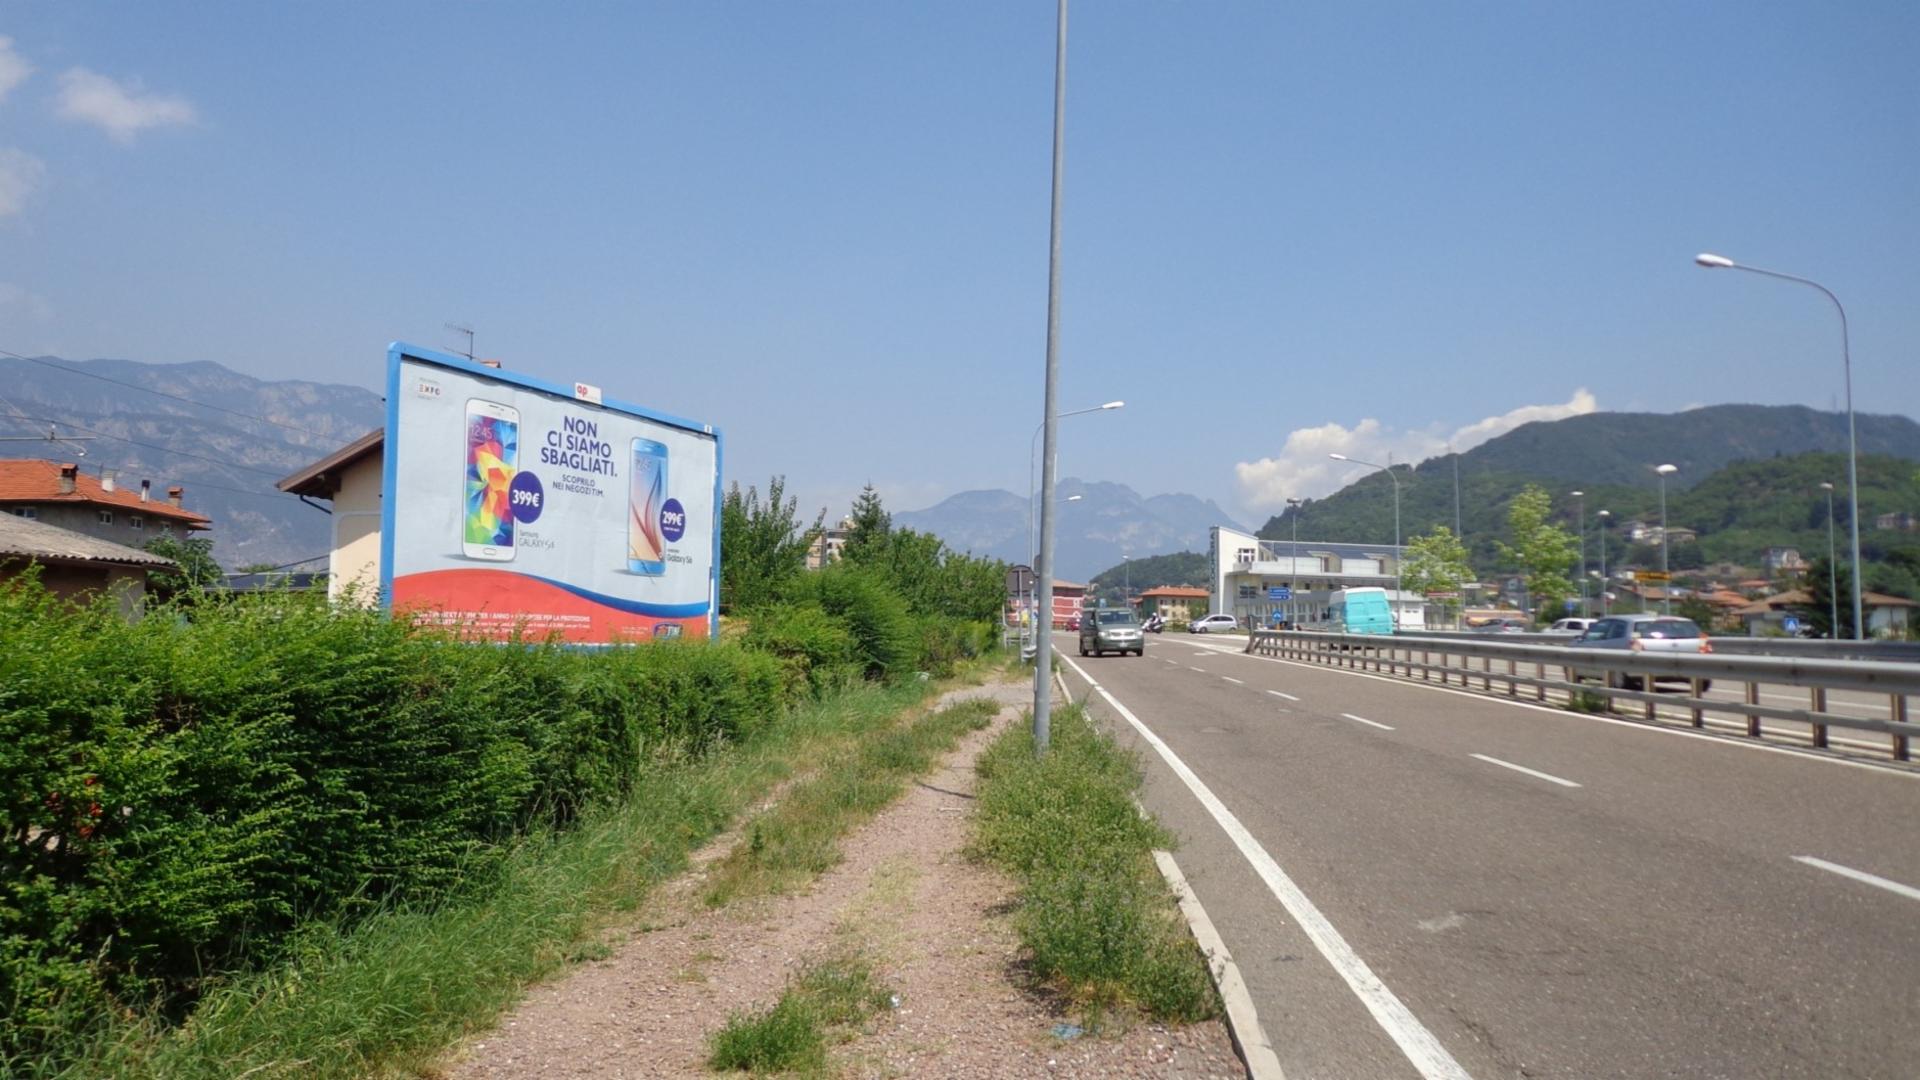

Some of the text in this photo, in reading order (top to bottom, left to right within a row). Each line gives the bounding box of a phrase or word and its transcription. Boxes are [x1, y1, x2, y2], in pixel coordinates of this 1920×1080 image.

[564, 415, 597, 438] NON
[547, 430, 612, 458] CI SIAMO
[541, 447, 618, 477] SBAGLIATI.
[553, 481, 564, 491] NEI
[565, 484, 591, 495] NEGOZI
[562, 474, 595, 487] SCOPRILO
[512, 489, 540, 507] 399€
[662, 511, 684, 526] 299€
